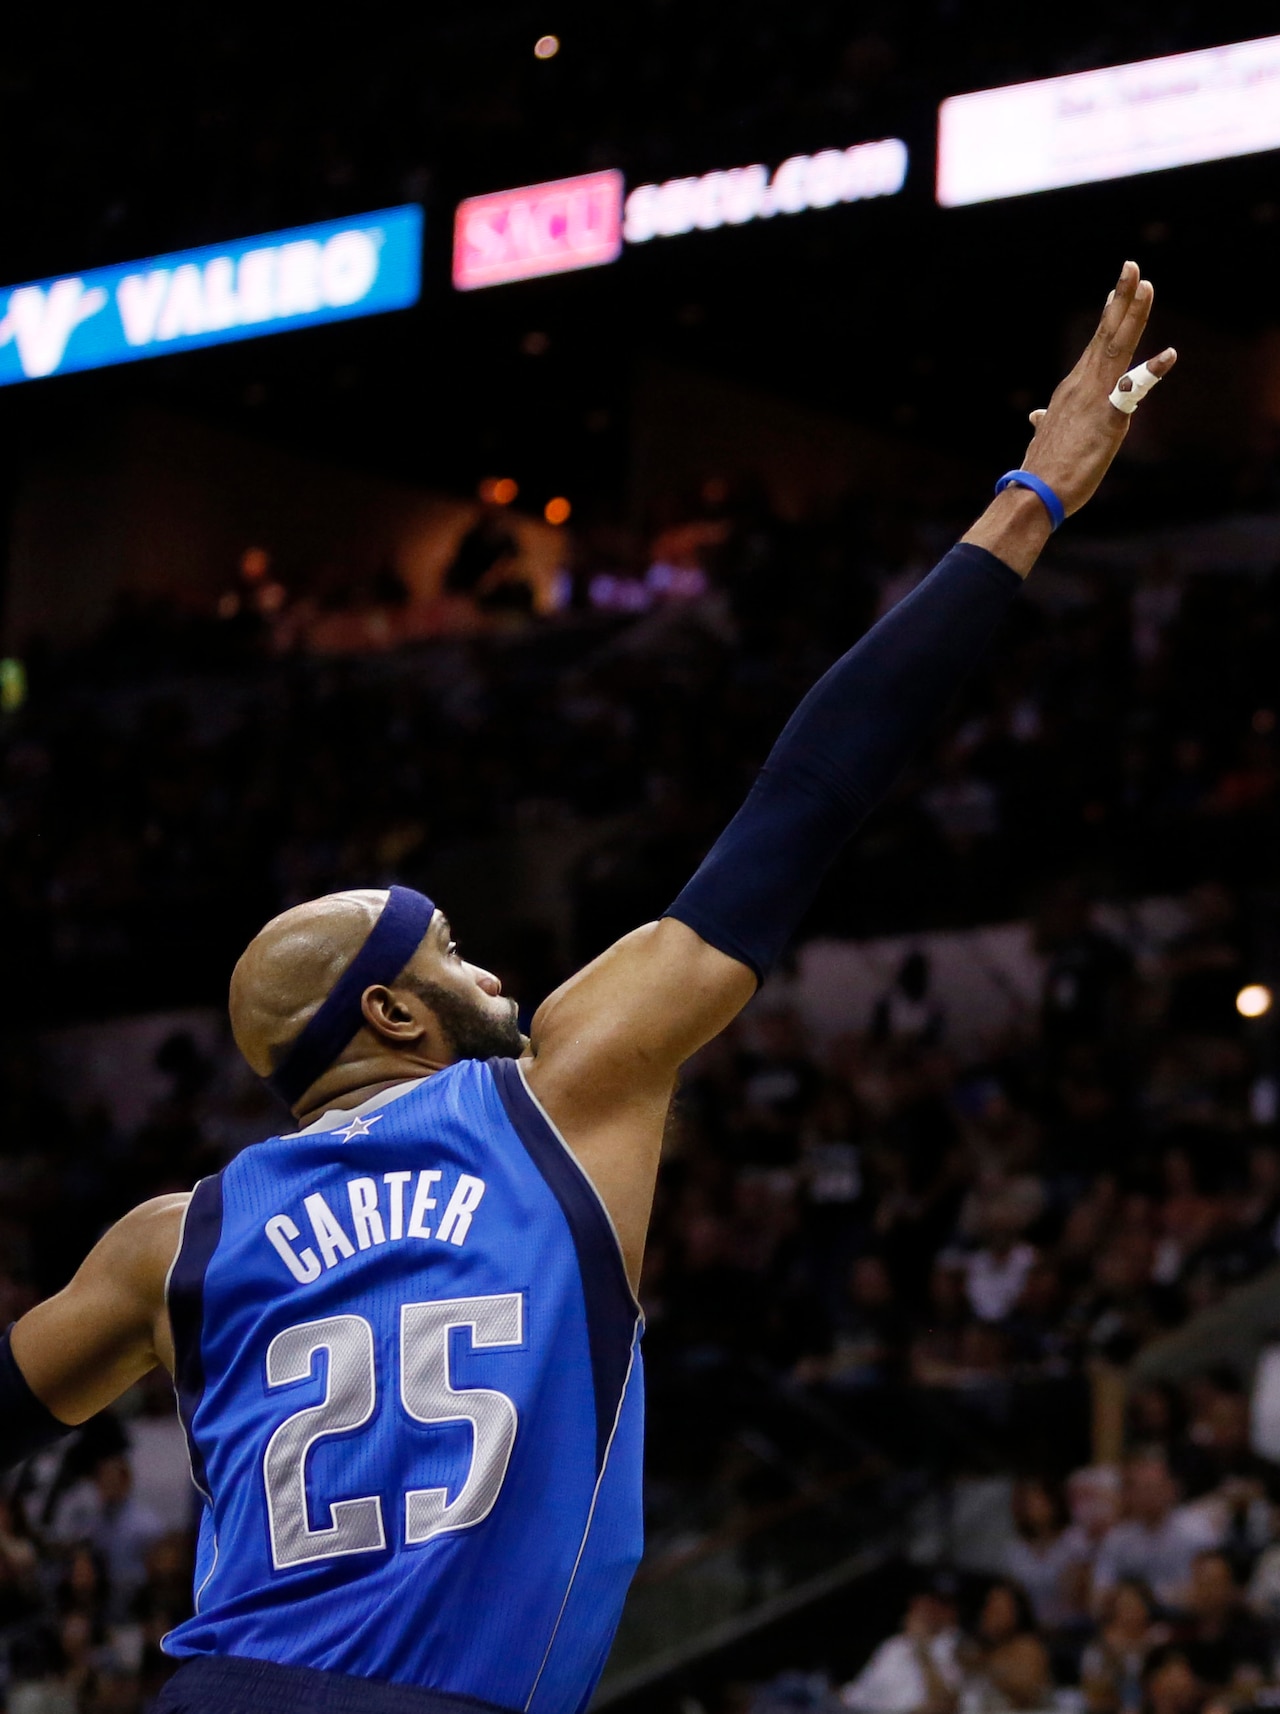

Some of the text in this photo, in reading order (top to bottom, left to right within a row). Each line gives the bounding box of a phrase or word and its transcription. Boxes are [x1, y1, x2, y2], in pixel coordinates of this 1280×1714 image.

[117, 228, 386, 346] VALERO
[264, 1169, 486, 1285] CARTER
[263, 1292, 523, 1571] 25
